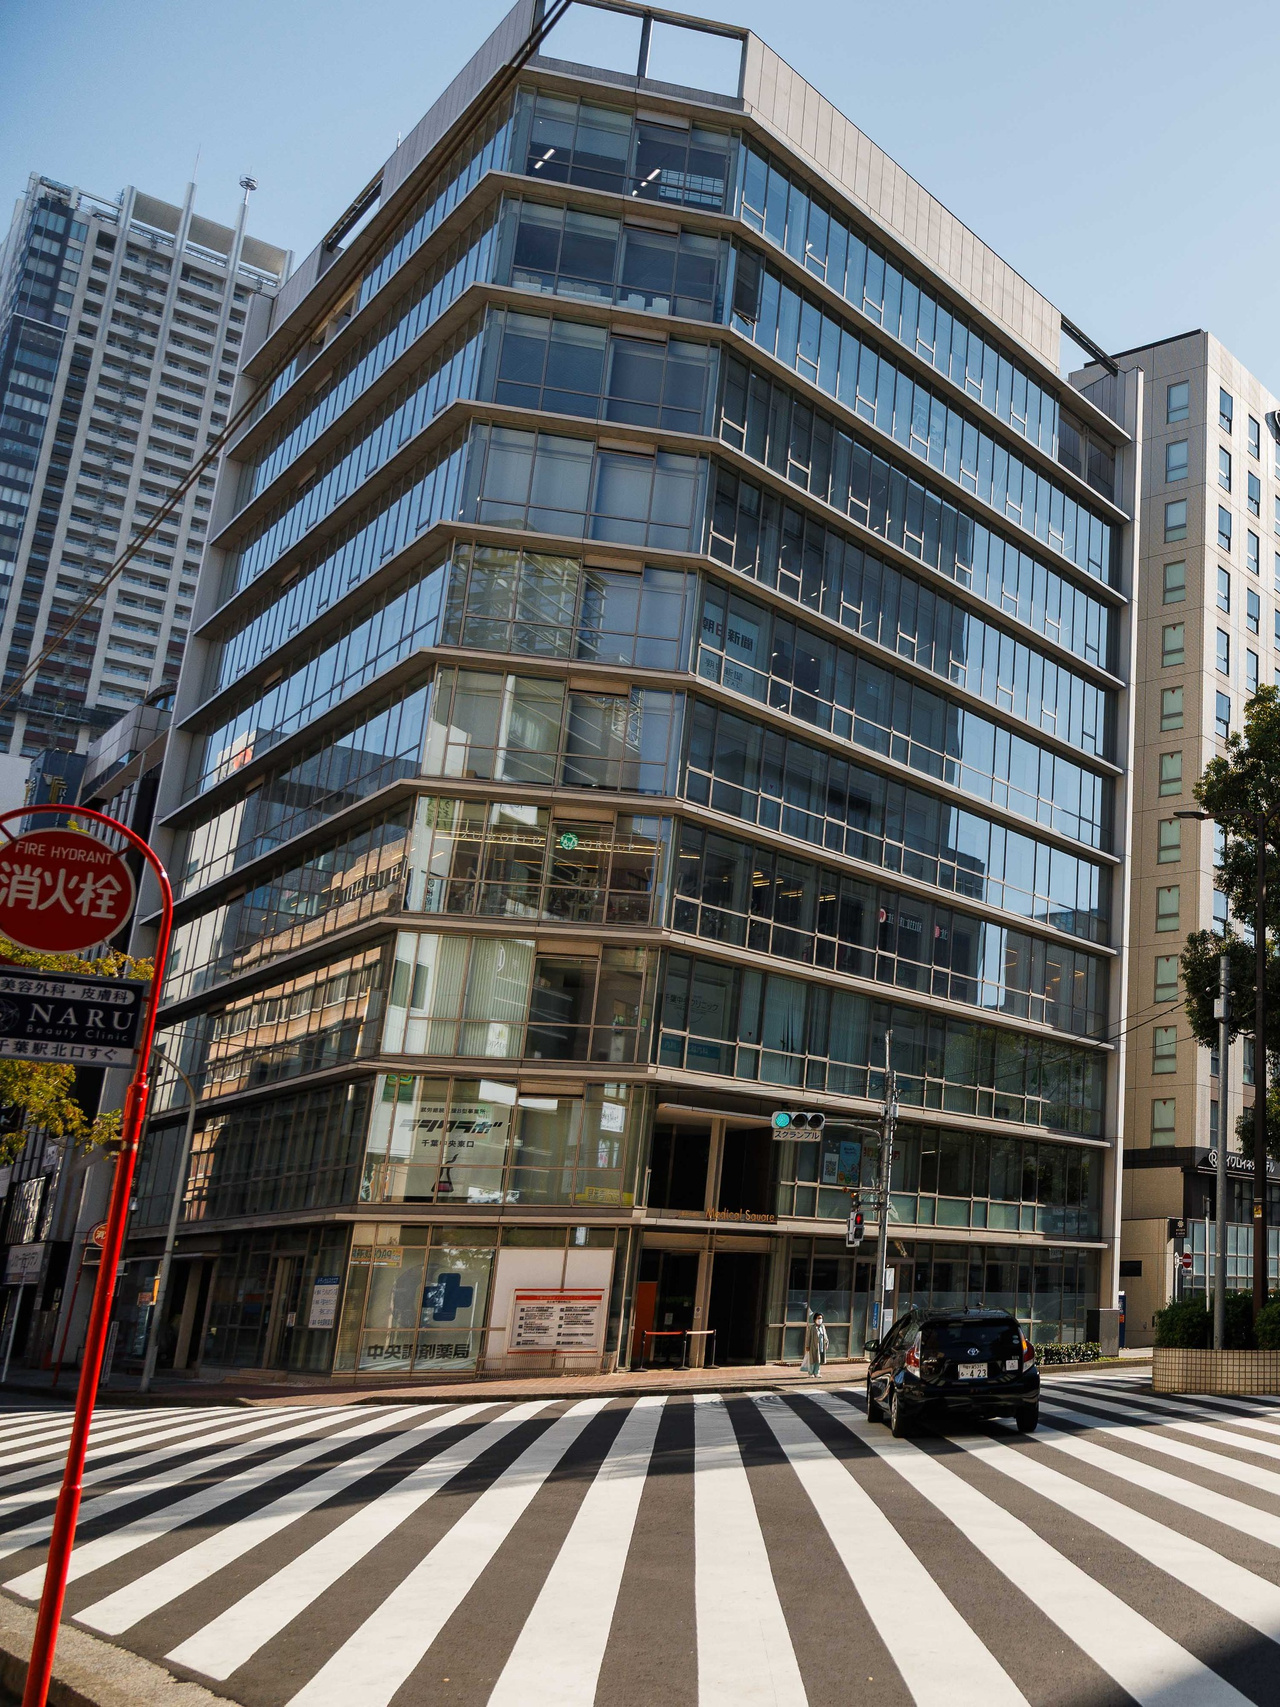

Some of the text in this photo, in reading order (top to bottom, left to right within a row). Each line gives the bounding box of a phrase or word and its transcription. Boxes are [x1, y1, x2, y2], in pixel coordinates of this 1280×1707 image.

[702, 616, 754, 652] 朝日新聞
[15, 841, 114, 865] FIRE HYDRANT
[0, 861, 122, 919] 消火栓
[1, 979, 128, 1003] 美容外科・皮膚科
[28, 1003, 135, 1031] NARU
[26, 1024, 128, 1041] Beauty Clinic
[774, 1130, 820, 1139] スクランブル
[705, 1203, 743, 1222] Medical
[745, 1209, 776, 1222] Square
[367, 1343, 471, 1360] 中央調剤薬局
